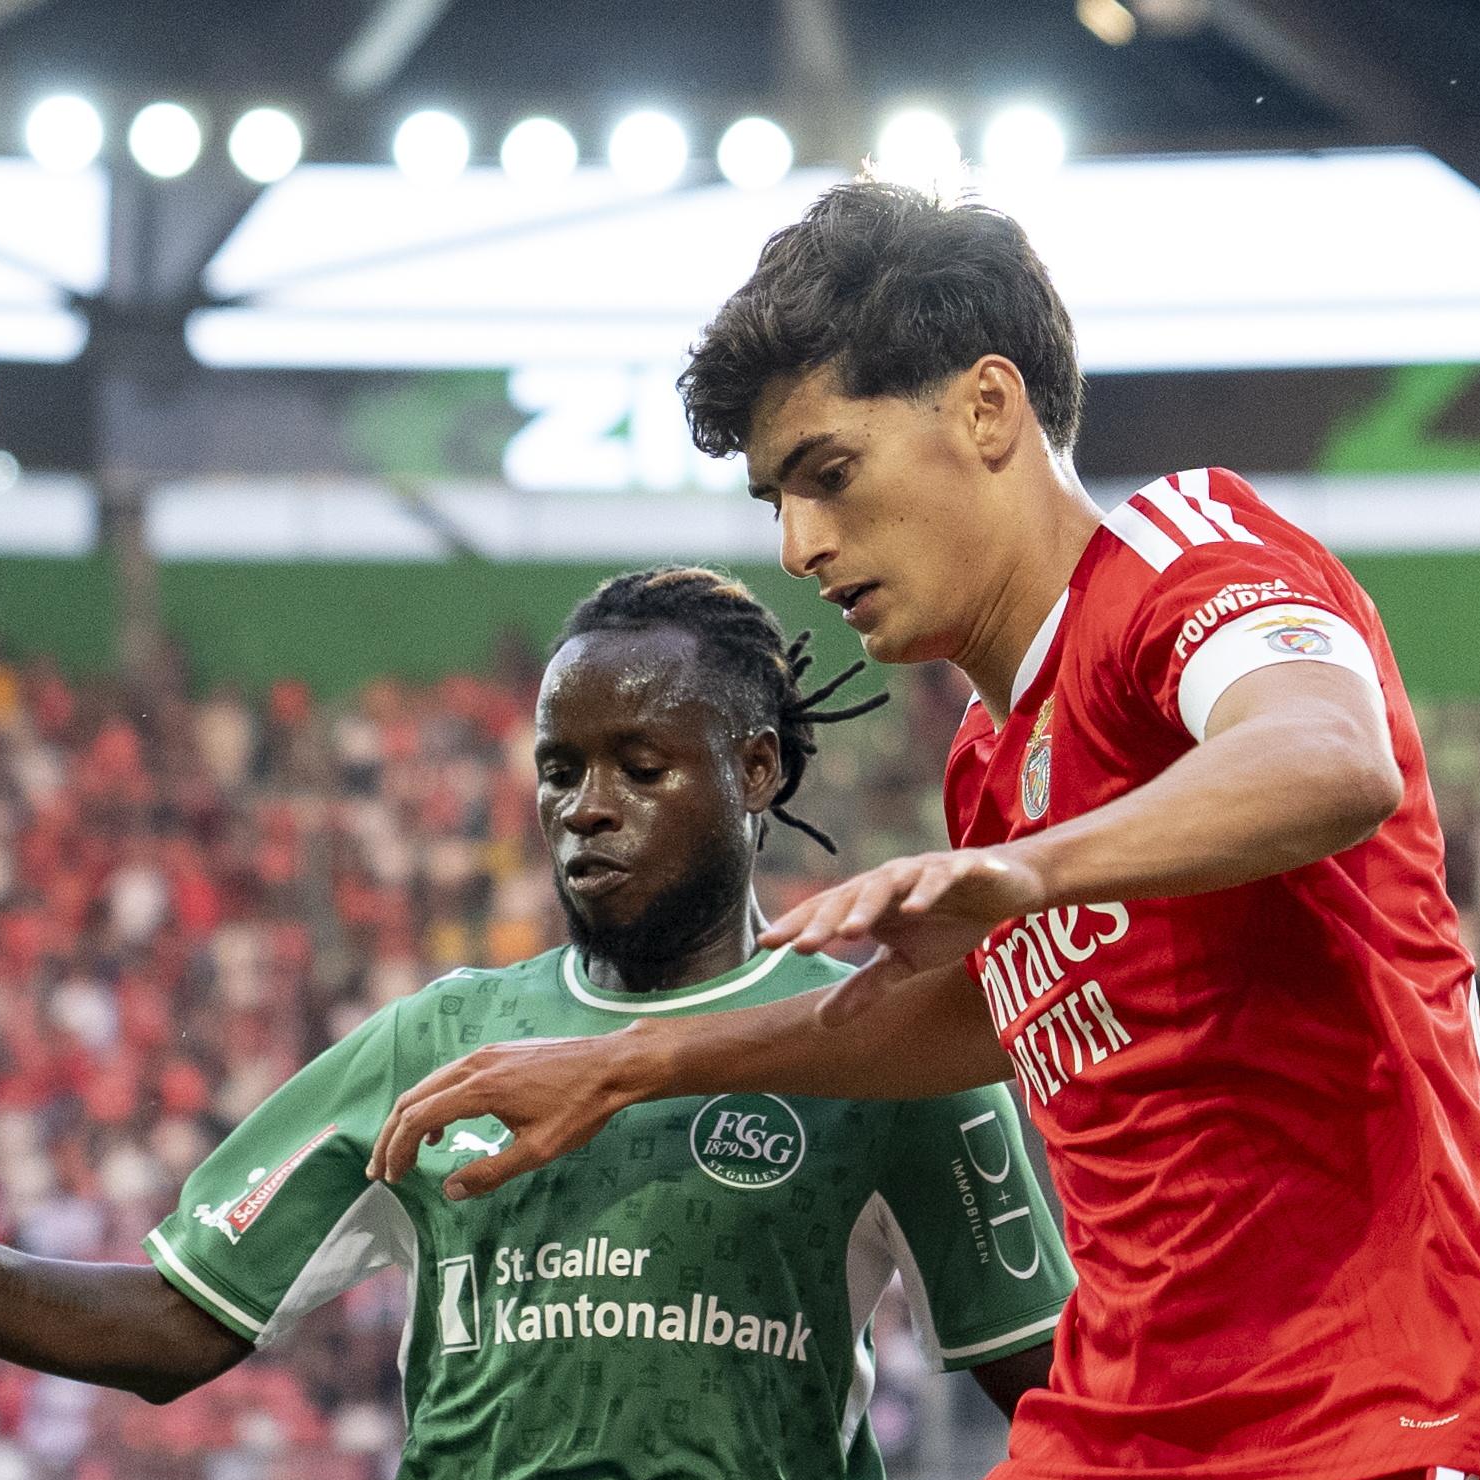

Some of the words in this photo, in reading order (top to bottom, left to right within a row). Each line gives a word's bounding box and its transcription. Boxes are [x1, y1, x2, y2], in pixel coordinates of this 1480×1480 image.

[703, 1140, 739, 1156] 1879
[726, 1168, 781, 1183] GALLEN
[951, 1157, 991, 1265] IMMOBILIEN
[494, 1293, 813, 1362] Kantonalbank
